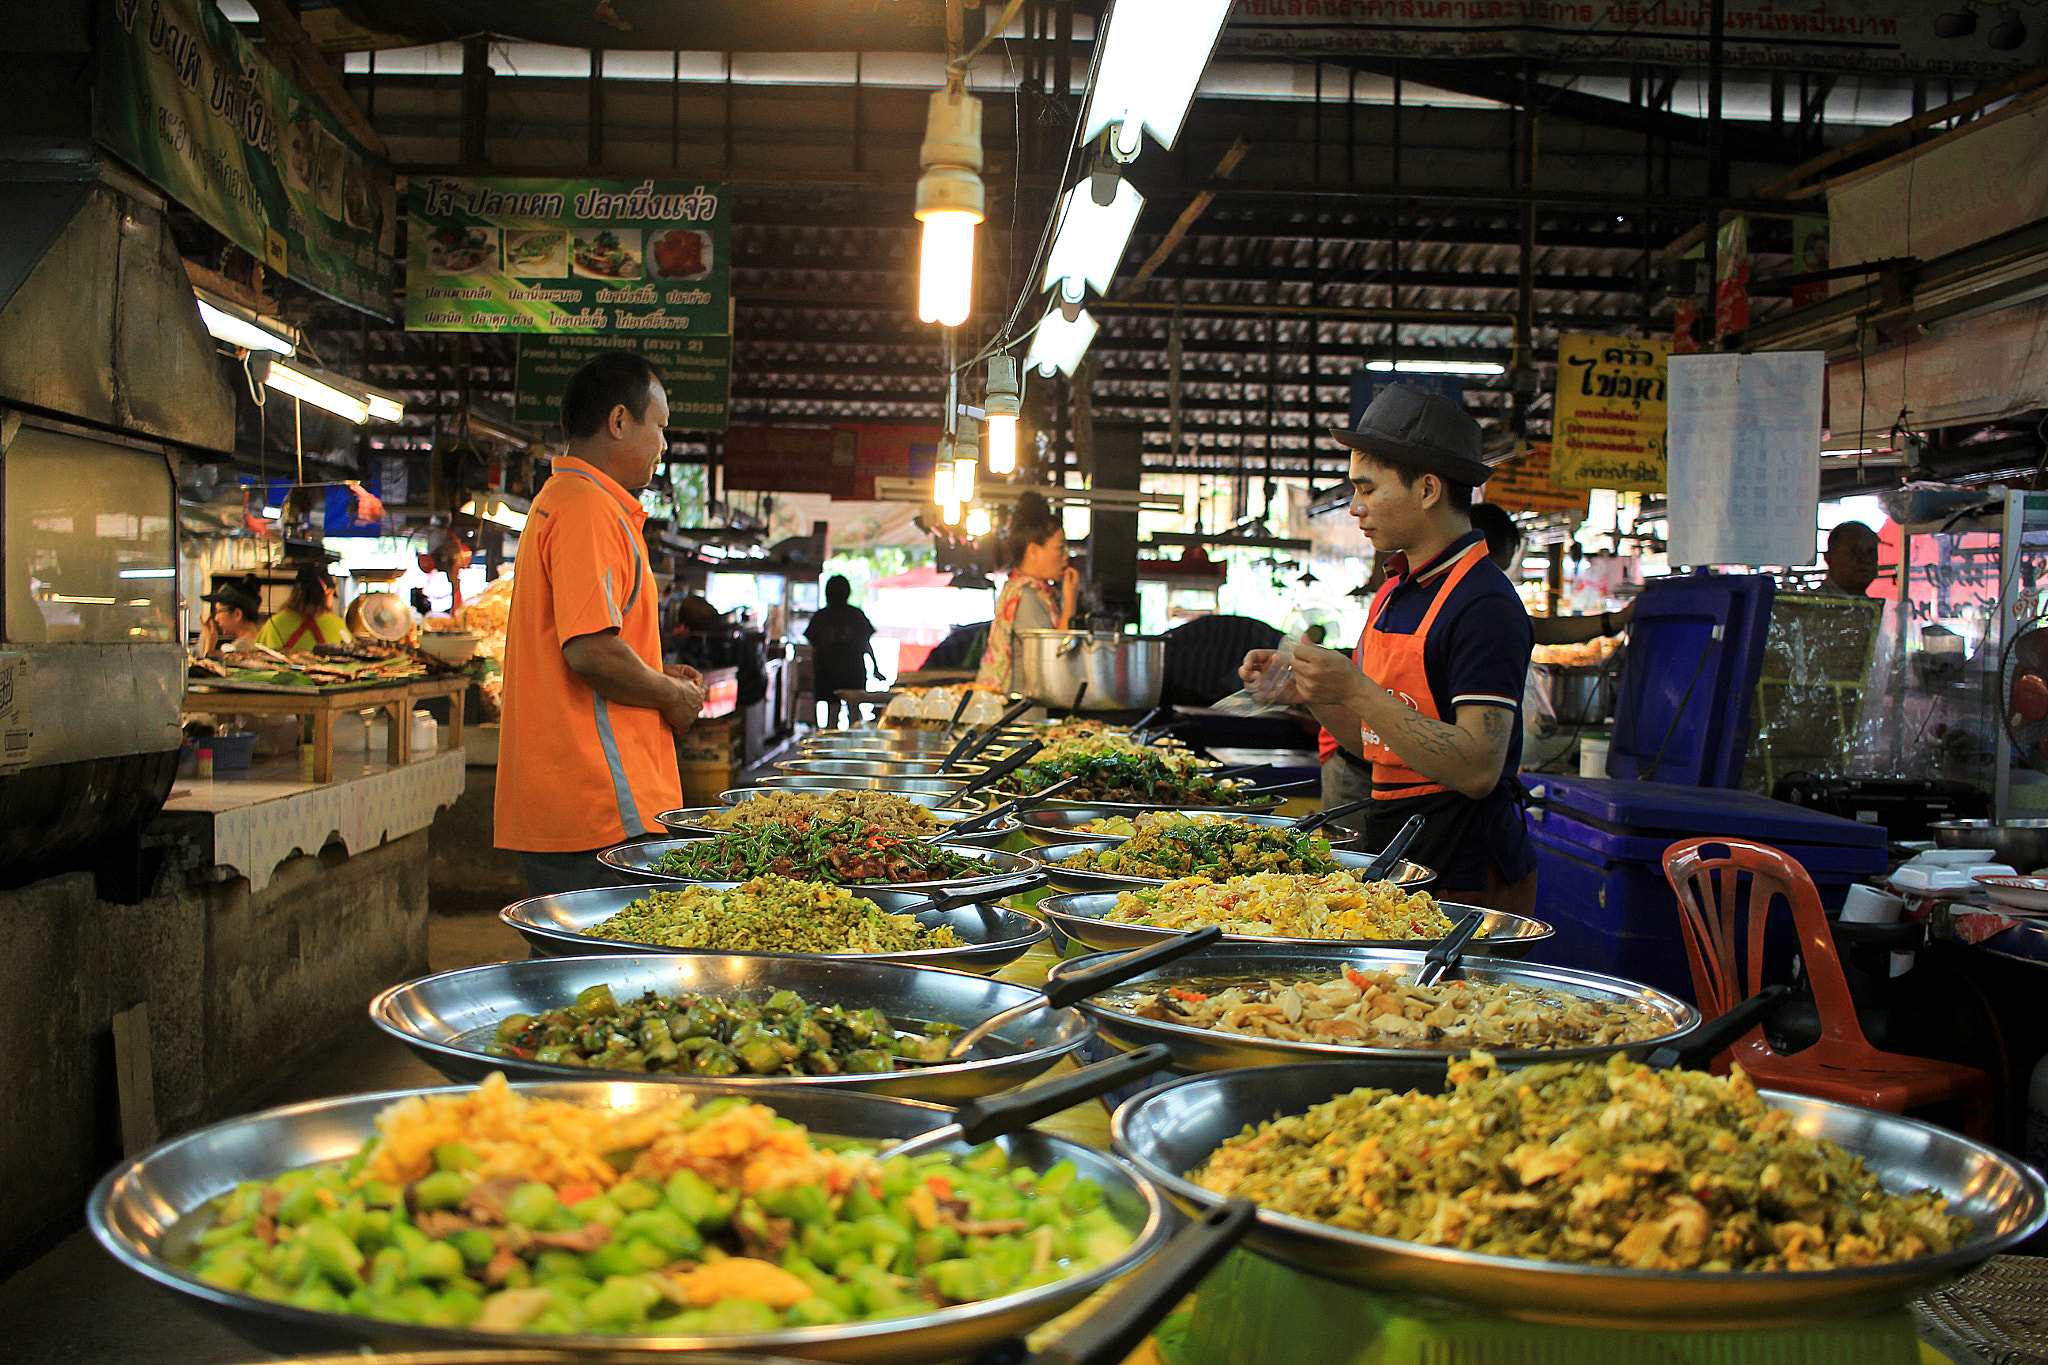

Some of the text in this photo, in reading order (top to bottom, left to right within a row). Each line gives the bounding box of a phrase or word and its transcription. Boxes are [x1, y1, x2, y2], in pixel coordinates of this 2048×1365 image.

[466, 186, 565, 218] ปลาเผา
[575, 179, 718, 222] ปลานึ่งแจ่ว
[1604, 342, 1653, 366] ครัว
